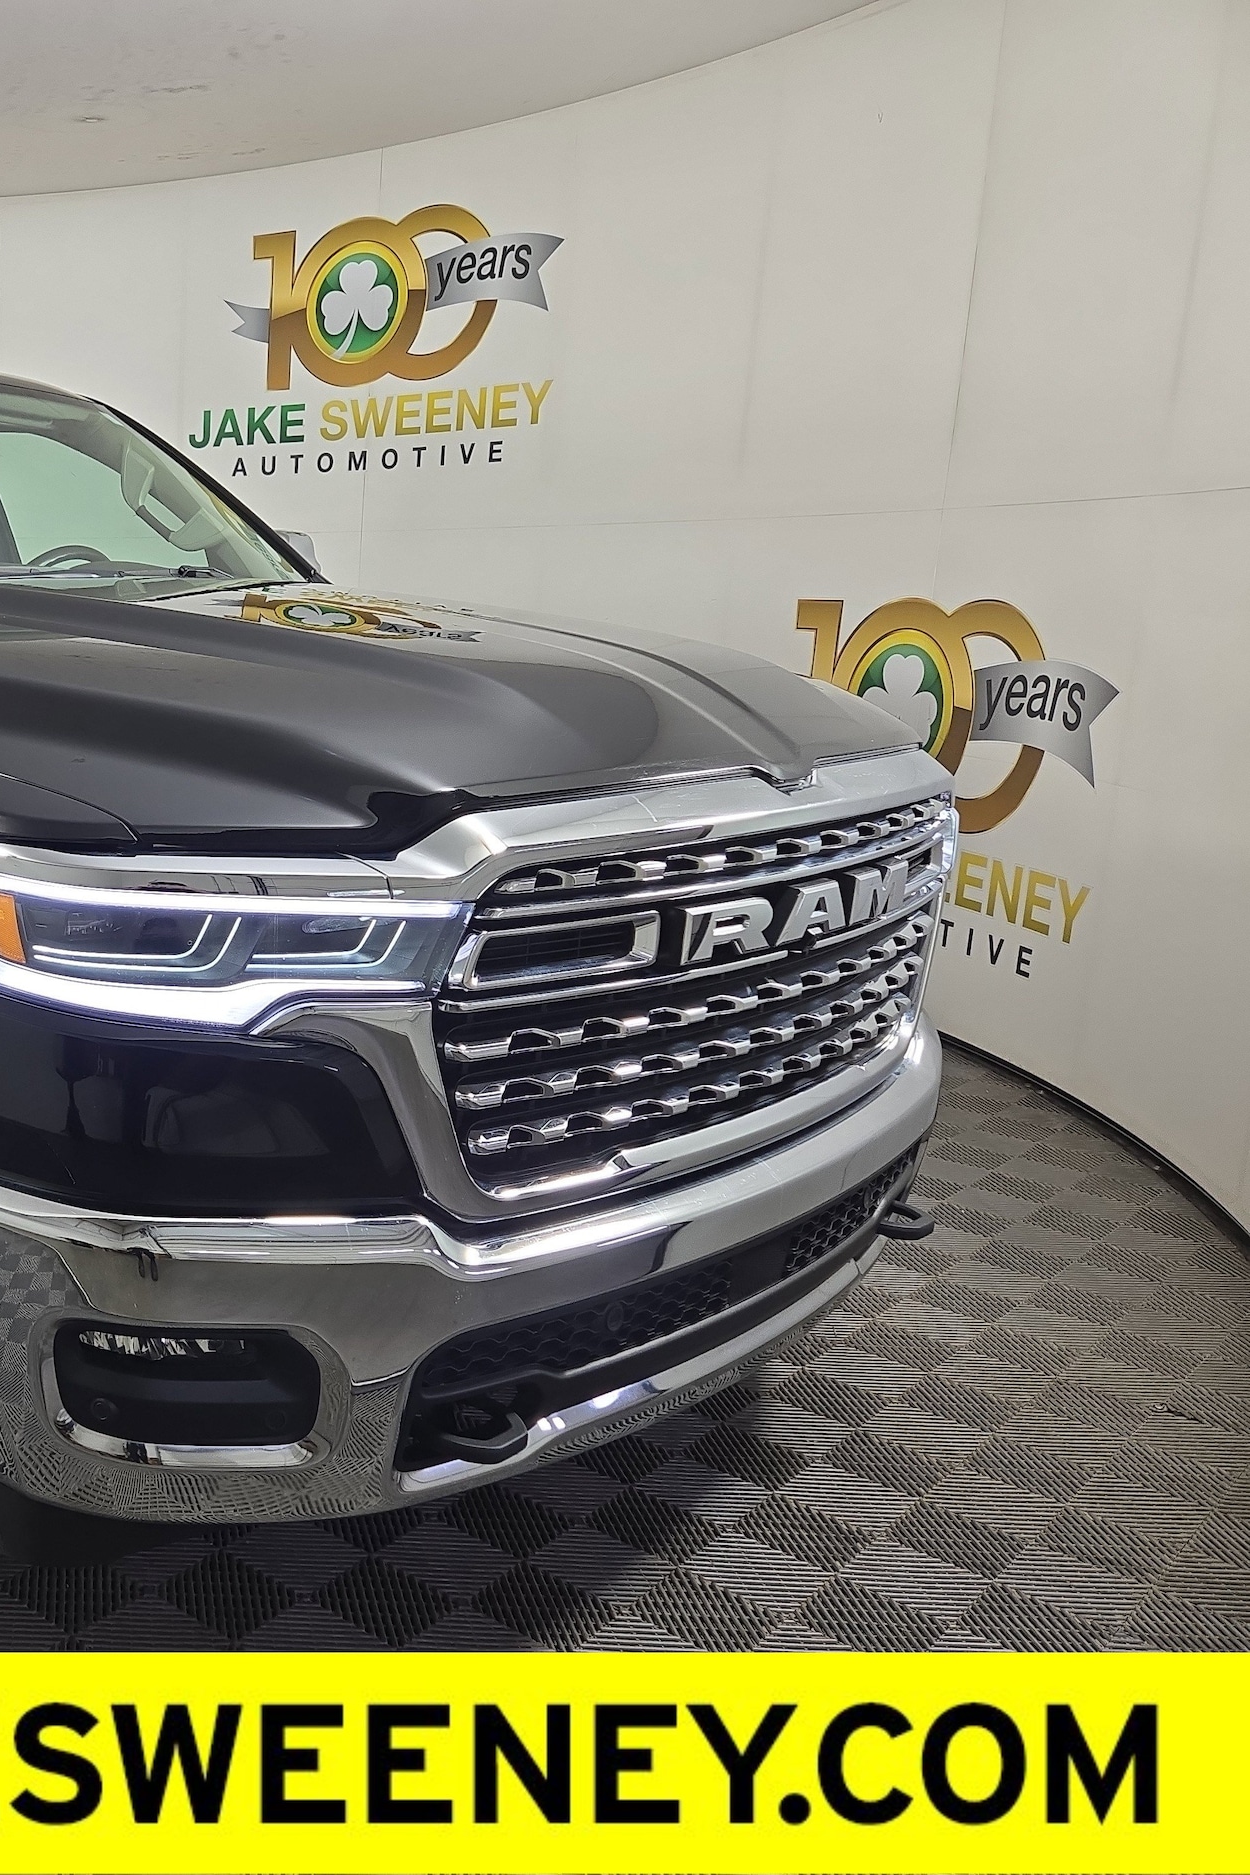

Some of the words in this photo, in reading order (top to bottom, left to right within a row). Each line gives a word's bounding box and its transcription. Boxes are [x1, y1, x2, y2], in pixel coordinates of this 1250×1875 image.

[253, 203, 498, 391] 100
[435, 242, 532, 301] years
[188, 404, 306, 449] JAKE
[319, 380, 553, 442] SWEENEY
[232, 440, 503, 477] AUTOMOTIVE
[979, 674, 1086, 732] years
[680, 857, 909, 967] RAM
[944, 849, 1094, 944] ENEY
